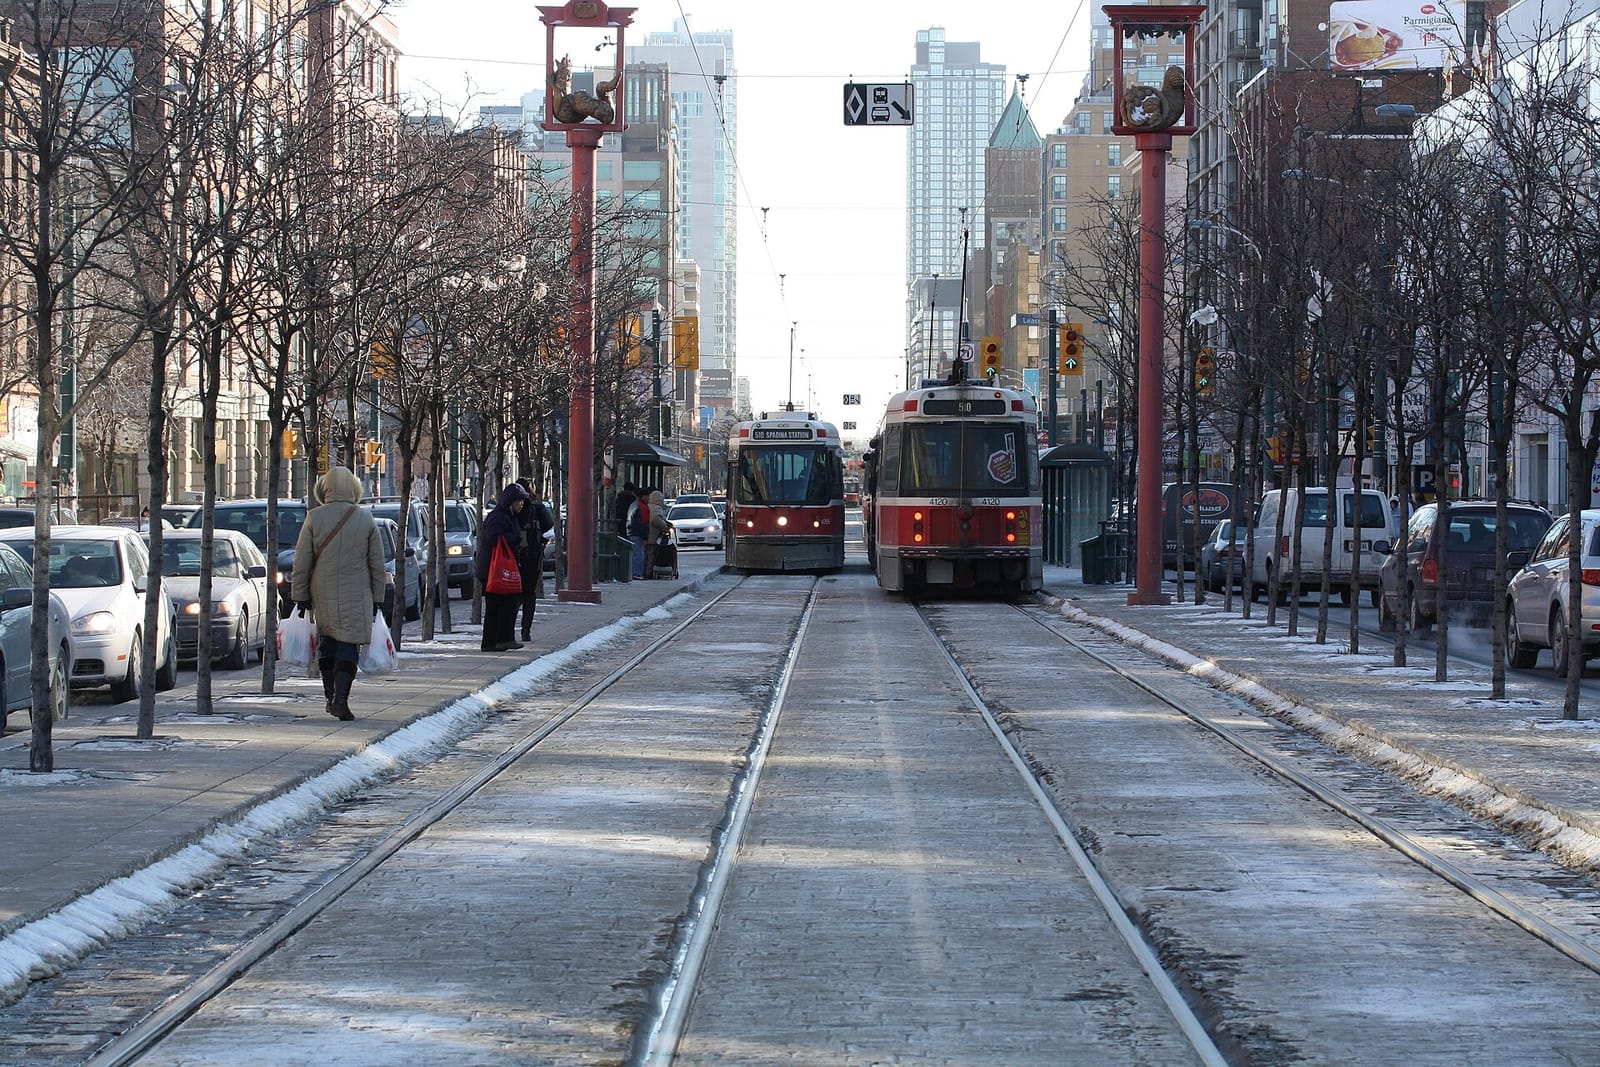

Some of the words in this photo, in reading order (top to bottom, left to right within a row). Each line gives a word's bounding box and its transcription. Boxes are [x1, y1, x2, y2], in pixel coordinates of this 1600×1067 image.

[754, 431, 765, 439] 510
[765, 431, 788, 439] SPADINA
[788, 431, 810, 439] STATION
[1420, 471, 1433, 487] P
[929, 498, 948, 506] 4120
[982, 498, 1001, 506] 4120
[1187, 504, 1222, 512] Suad
